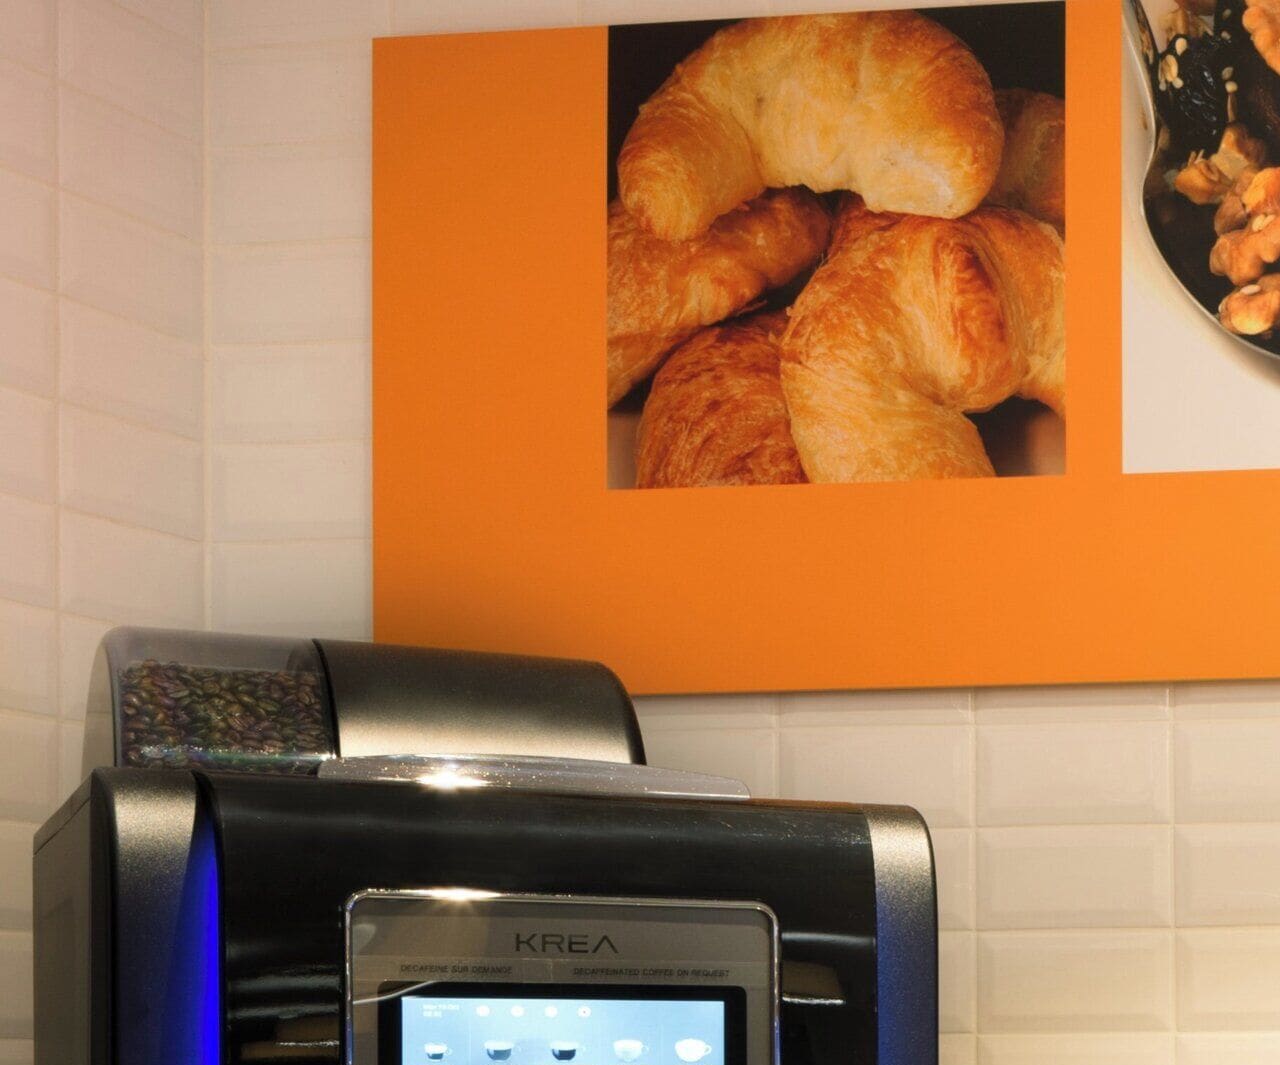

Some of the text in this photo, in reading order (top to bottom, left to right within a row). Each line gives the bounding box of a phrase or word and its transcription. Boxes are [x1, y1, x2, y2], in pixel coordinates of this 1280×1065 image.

[514, 932, 620, 954] KREA
[450, 965, 470, 974] SUR
[471, 965, 513, 975] DEMANDE
[573, 967, 730, 978] DECAFFEINATED COFFEE ON REQUEST
